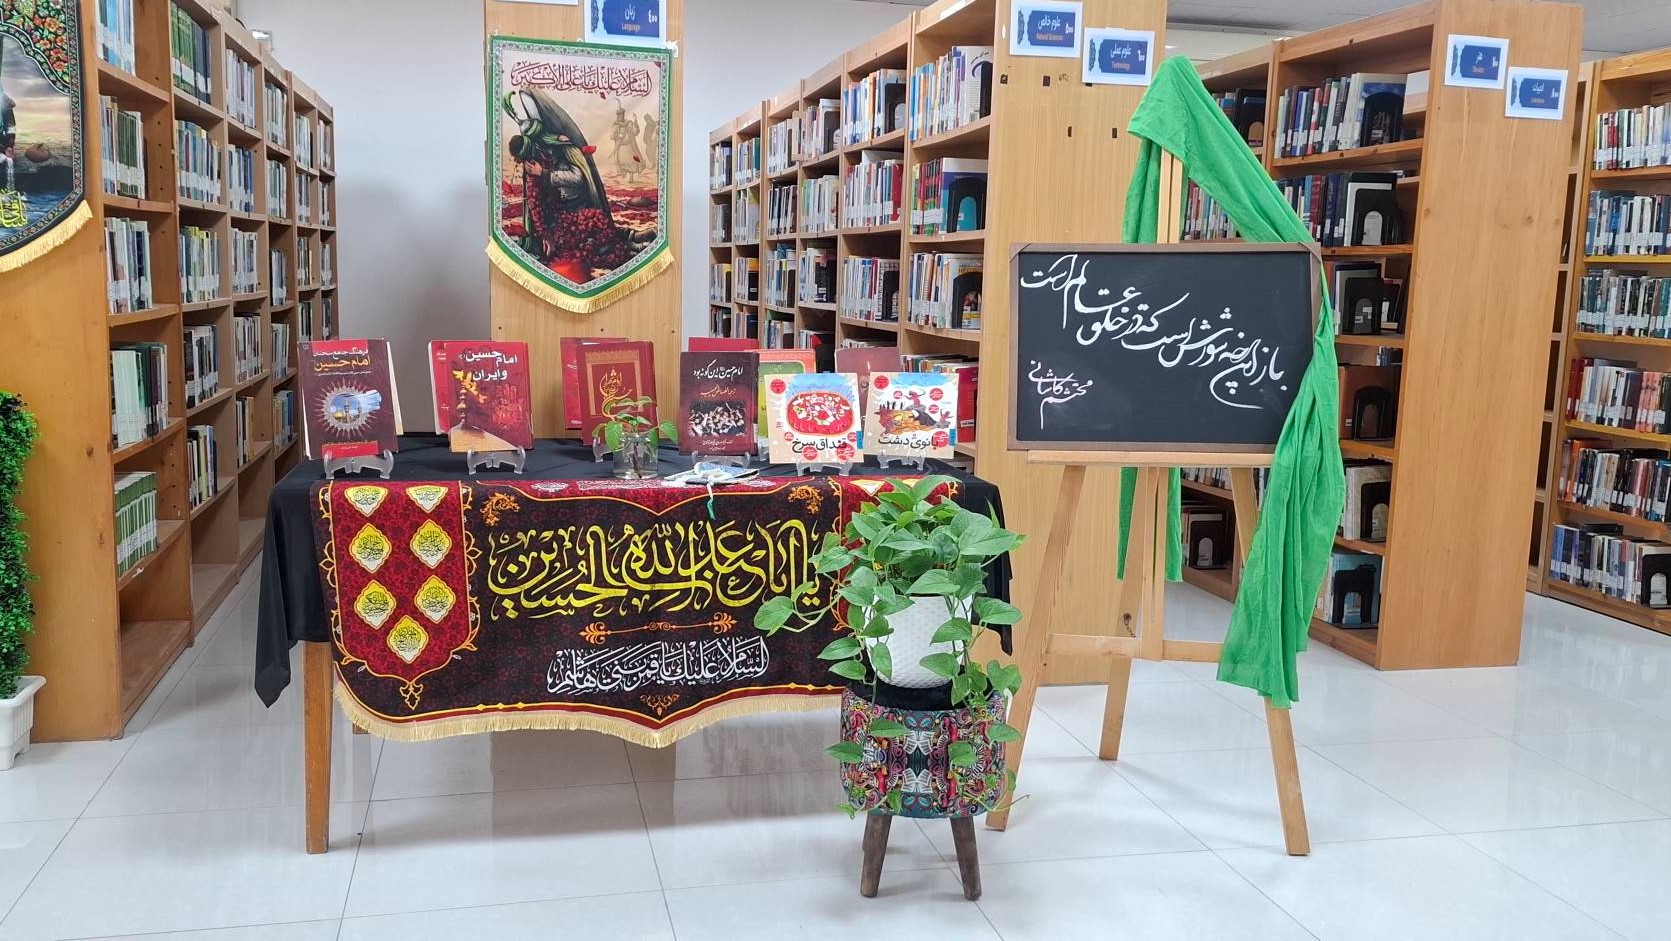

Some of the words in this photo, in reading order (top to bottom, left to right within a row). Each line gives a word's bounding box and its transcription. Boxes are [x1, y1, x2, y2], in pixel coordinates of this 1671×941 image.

[624, 3, 636, 21] زبان
[621, 22, 641, 32] Language
[1050, 15, 1061, 31] علوم
[1121, 44, 1132, 59] علوم
[1020, 254, 1078, 291] است
[1062, 260, 1142, 330] عالم
[1135, 293, 1190, 334] که
[1076, 304, 1129, 346] خلق
[1111, 312, 1144, 340] در
[1121, 317, 1197, 352] است
[1158, 307, 1234, 368] شورش
[332, 350, 349, 360] جامع
[349, 346, 369, 356] فرهنگ
[465, 349, 502, 362] حسین
[313, 359, 351, 372] حسین
[351, 355, 371, 369] امام
[496, 354, 518, 367] امام
[1248, 345, 1288, 391] باز
[472, 368, 500, 382] ایران
[502, 369, 508, 380] و
[693, 369, 701, 380] بود
[707, 366, 719, 379] این
[718, 365, 736, 379] حسین
[731, 366, 744, 381] امام
[1028, 360, 1079, 395] کاشانی
[1040, 380, 1093, 431] محتشم
[791, 438, 816, 454] سرخ
[815, 437, 848, 451] قنداق
[878, 435, 910, 446] دشت
[910, 435, 939, 451] بانوی
